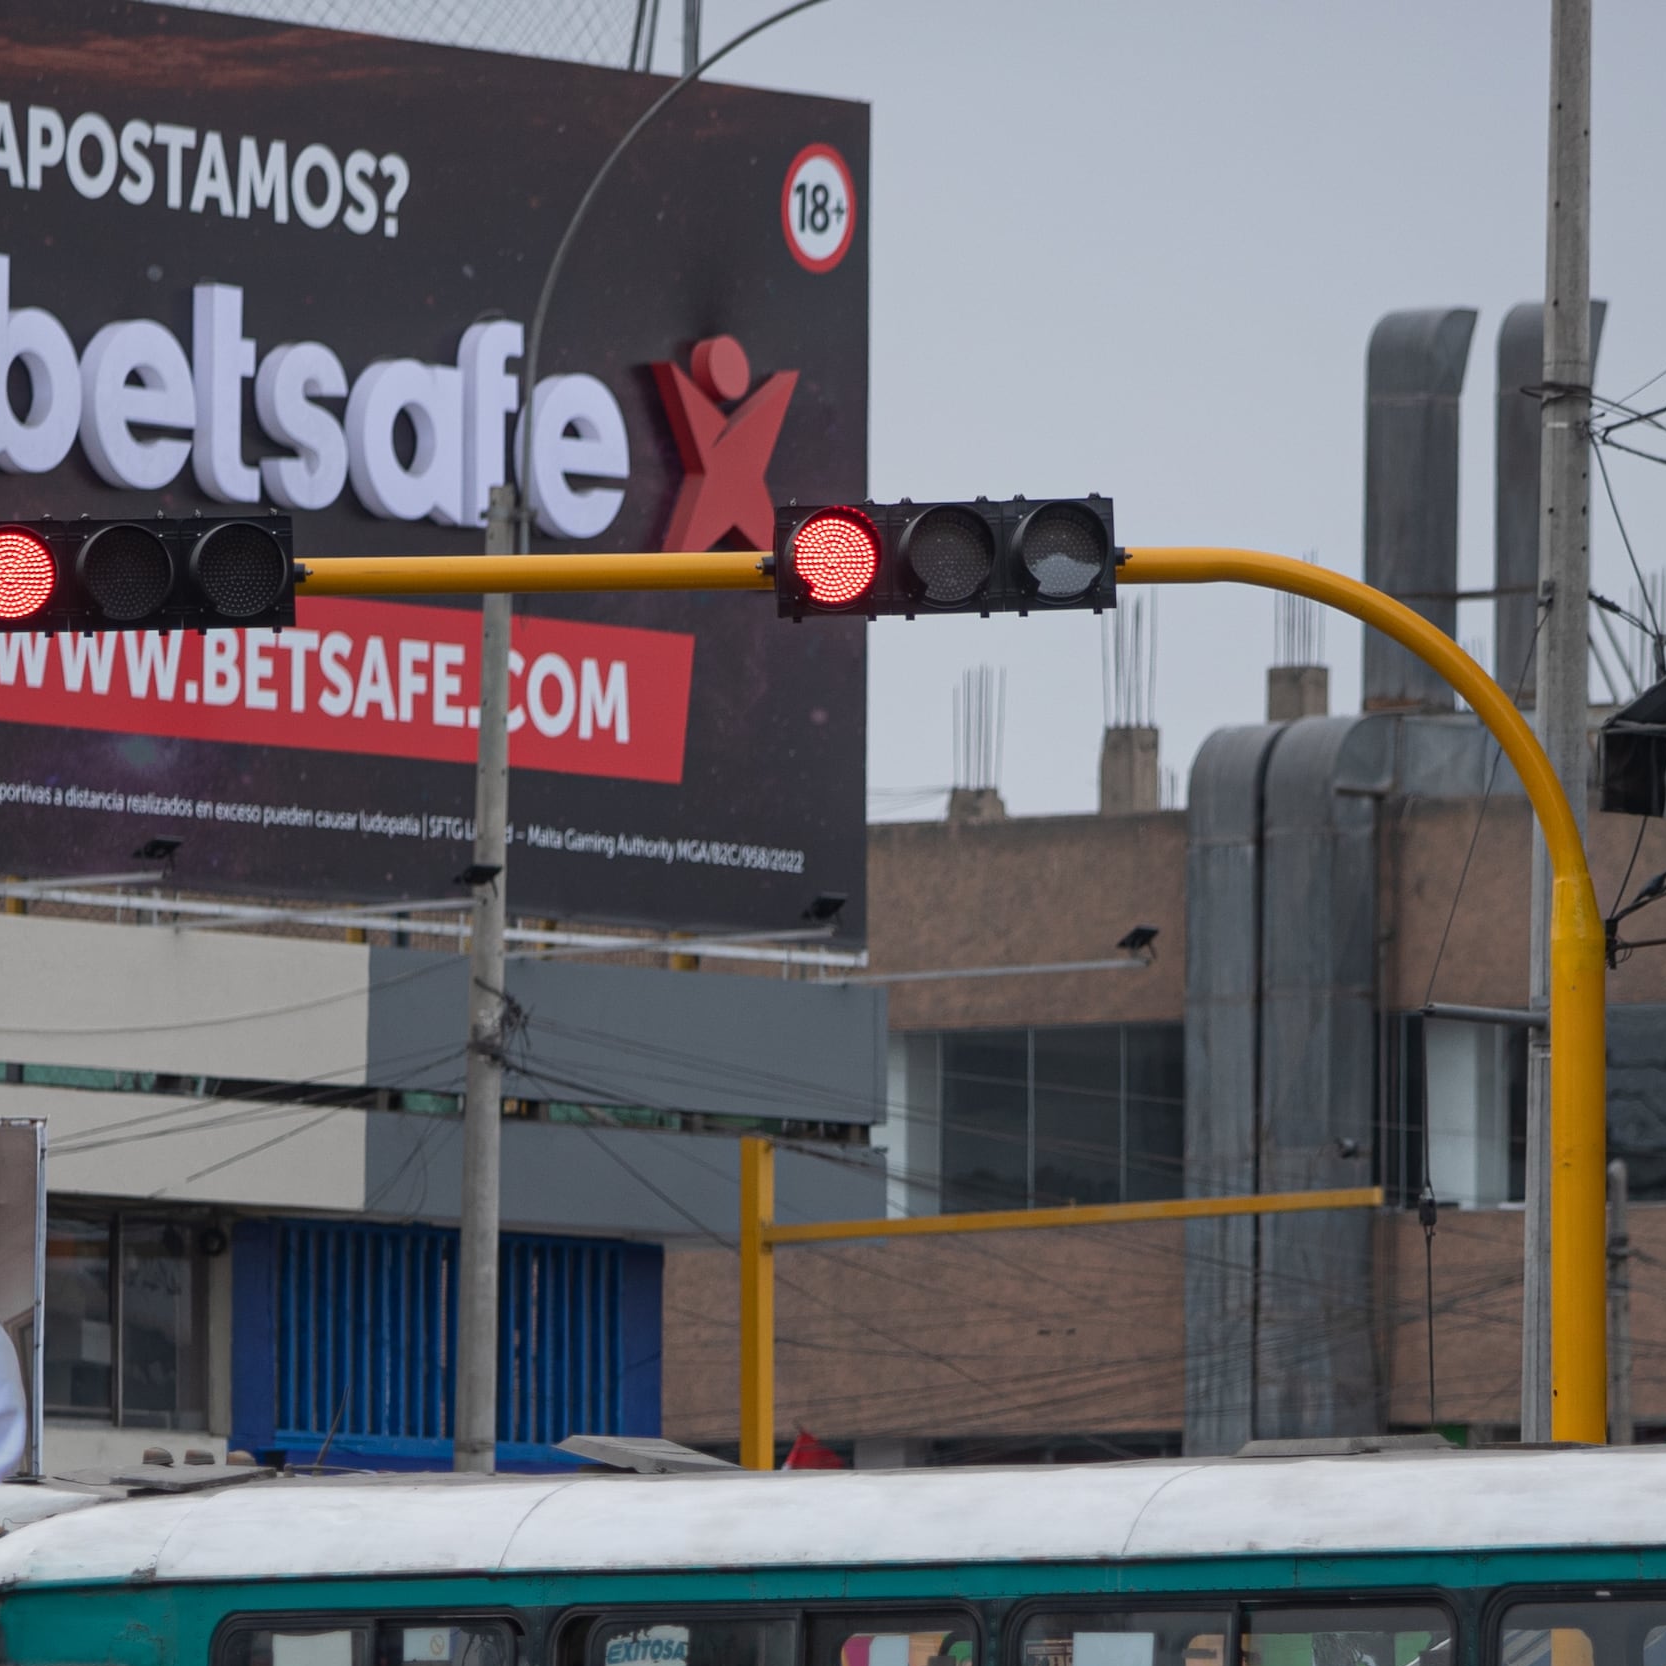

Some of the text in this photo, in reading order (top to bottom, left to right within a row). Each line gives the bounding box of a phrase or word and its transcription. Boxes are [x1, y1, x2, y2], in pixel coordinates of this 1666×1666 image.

[795, 182, 848, 235] 18+
[54, 787, 63, 805] a
[65, 784, 125, 812] distancia
[126, 792, 194, 819] realizados
[196, 799, 213, 820] en
[215, 802, 261, 824] exceso
[263, 803, 313, 829] pueden
[315, 808, 358, 831] causar
[564, 827, 615, 859] Gaming
[617, 832, 674, 865] Authority
